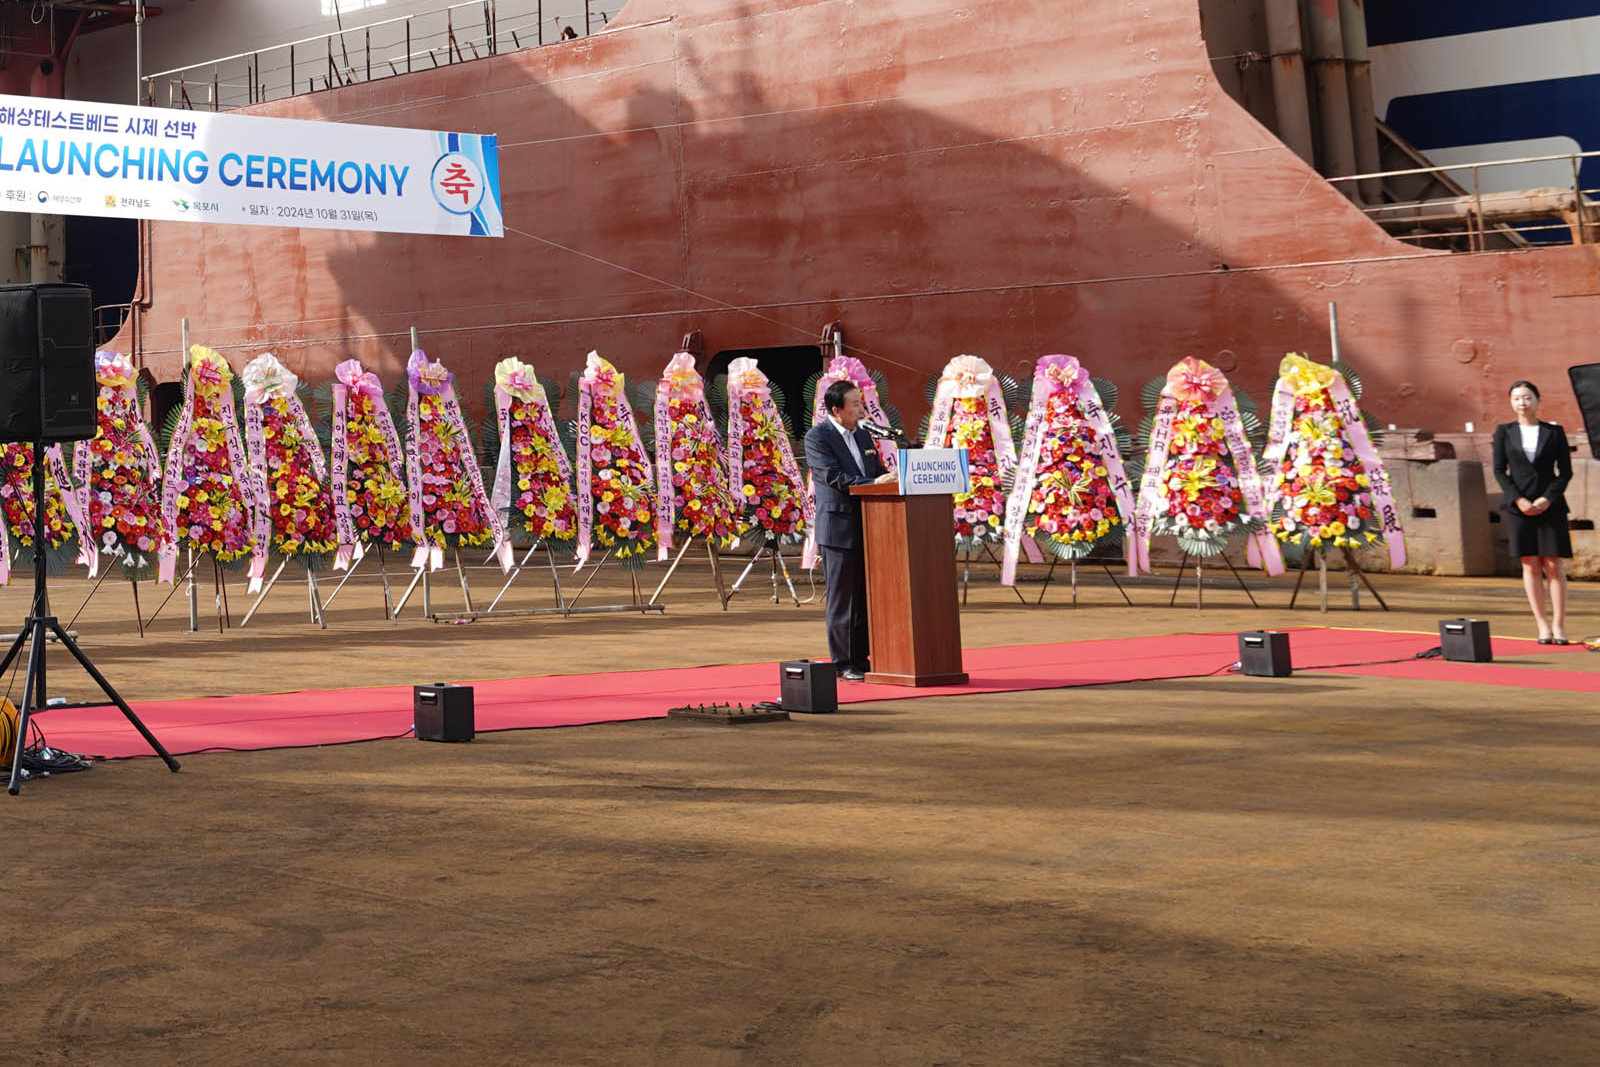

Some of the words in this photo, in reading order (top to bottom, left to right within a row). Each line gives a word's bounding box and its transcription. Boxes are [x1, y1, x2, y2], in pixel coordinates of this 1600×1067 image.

[126, 117, 159, 138] 시제
[163, 119, 198, 141] 선박
[218, 151, 411, 197] CEREMONY
[439, 161, 476, 205] 축
[5, 189, 26, 202] 후원
[120, 197, 151, 208] 전라남도
[249, 204, 269, 216] 일자
[277, 206, 313, 219] 2024년
[316, 208, 338, 220] 10월
[341, 209, 378, 223] 31일(목)
[222, 404, 244, 468] 진수식을
[911, 460, 957, 472] LAUNCHING
[912, 473, 957, 485] CEREMONY
[334, 482, 347, 506] 대표
